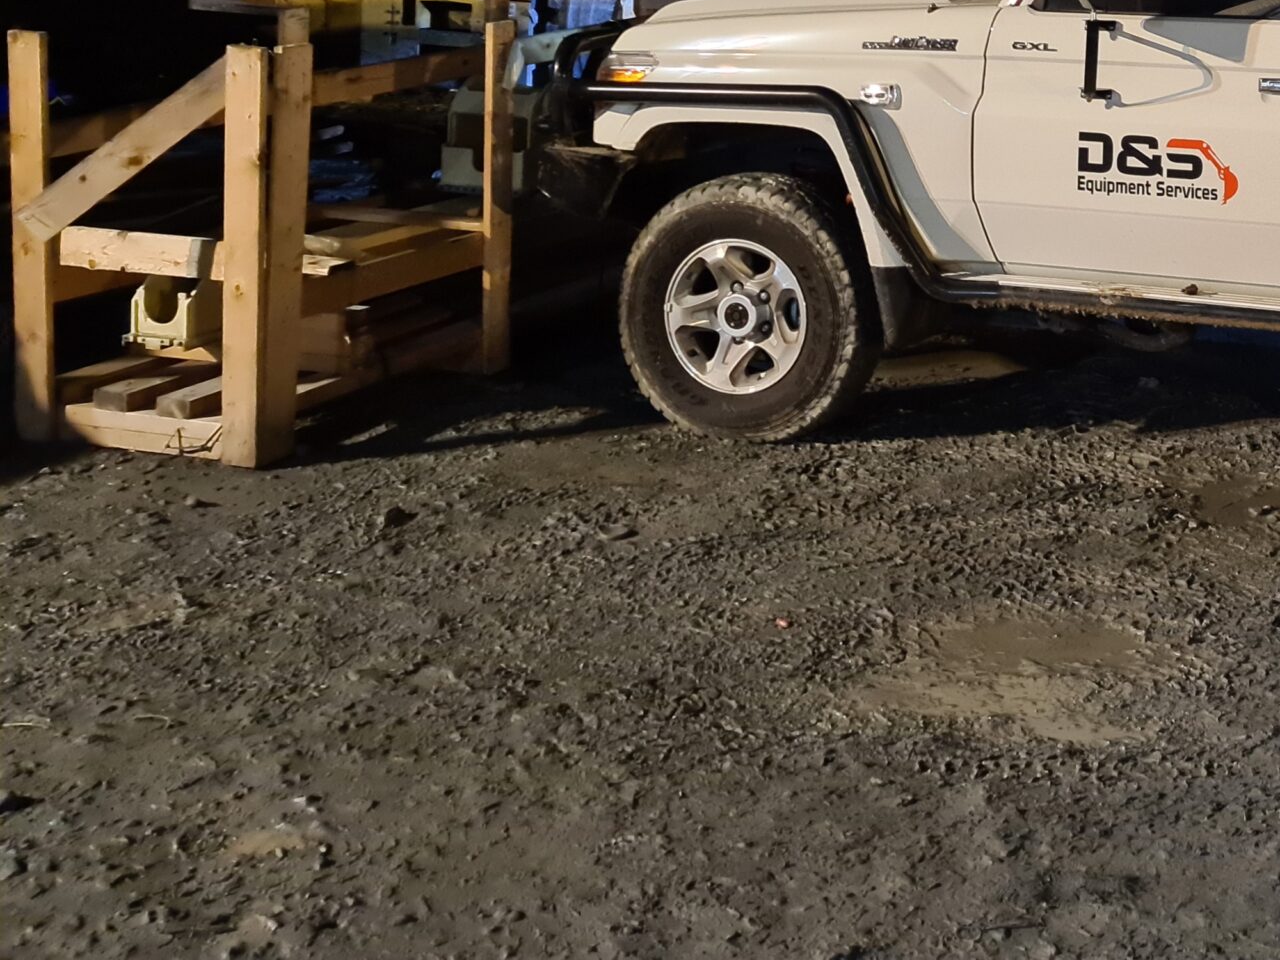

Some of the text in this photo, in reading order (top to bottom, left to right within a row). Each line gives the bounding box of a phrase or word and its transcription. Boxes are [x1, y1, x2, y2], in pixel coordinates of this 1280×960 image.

[1012, 41, 1058, 52] GXL
[1078, 131, 1203, 180] D&S
[1077, 175, 1218, 201] Equipment Services
